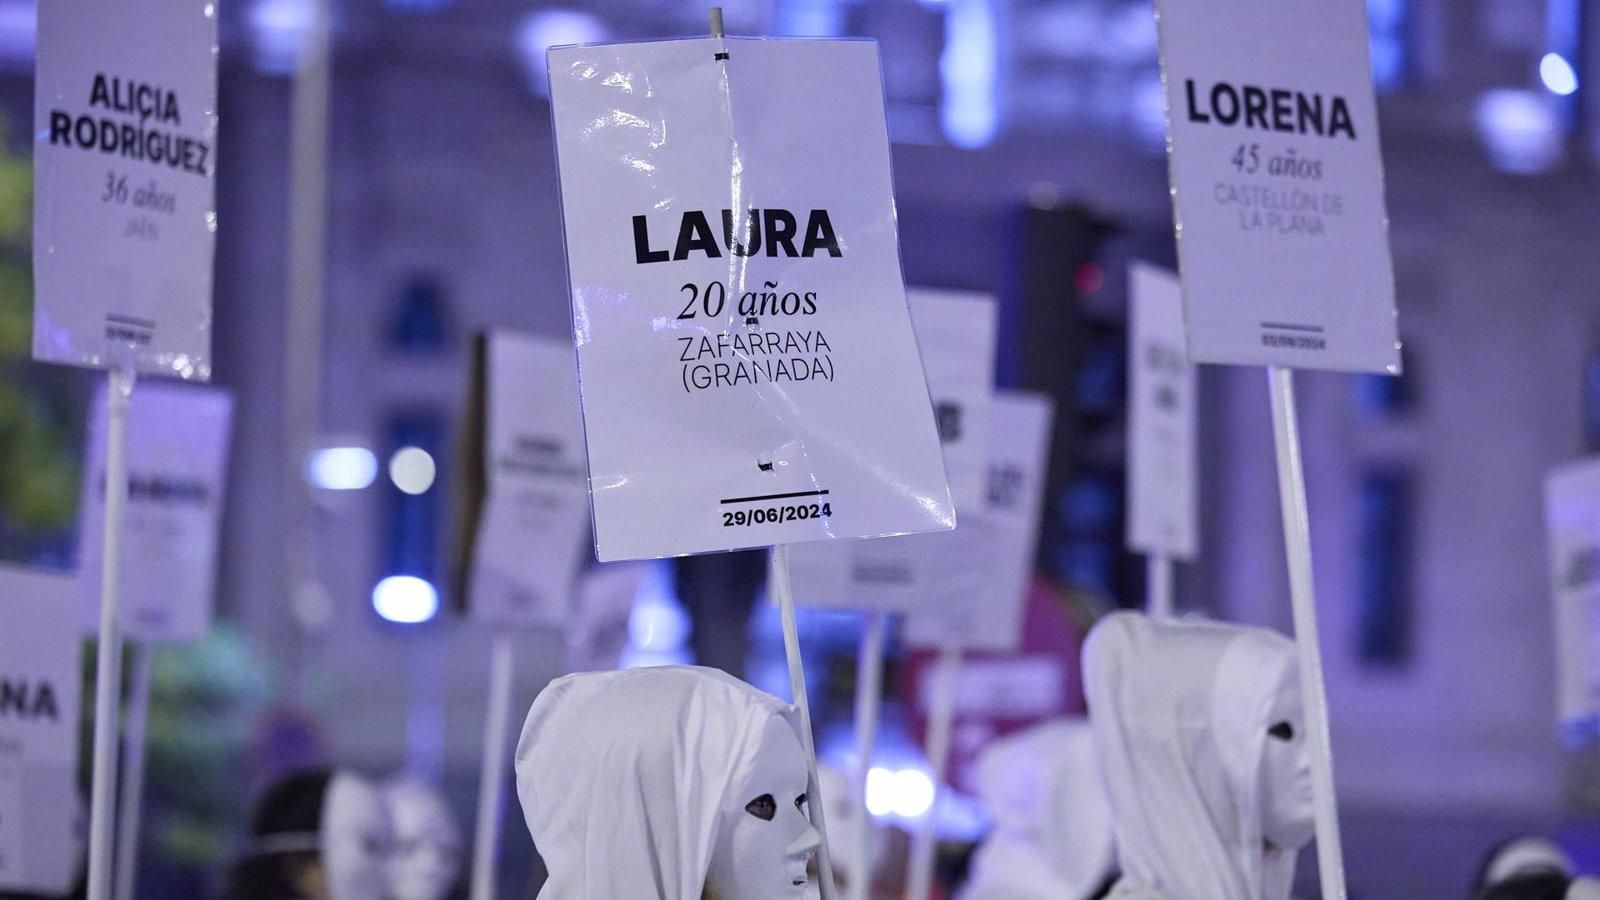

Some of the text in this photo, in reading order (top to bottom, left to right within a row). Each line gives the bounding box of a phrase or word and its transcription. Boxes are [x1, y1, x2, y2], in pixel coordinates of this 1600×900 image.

[90, 73, 181, 125] ALICIA
[1186, 79, 1357, 140] LORENA
[50, 110, 209, 177] RODRÍGUEZ
[1231, 143, 1323, 181] 45 años
[101, 172, 129, 204] 36
[632, 208, 843, 264] LAURA
[676, 280, 818, 320] 20 años
[678, 330, 832, 362] ZAFARRAYA
[682, 354, 834, 393] (GRANADA)
[722, 502, 833, 527] 29/06/2024
